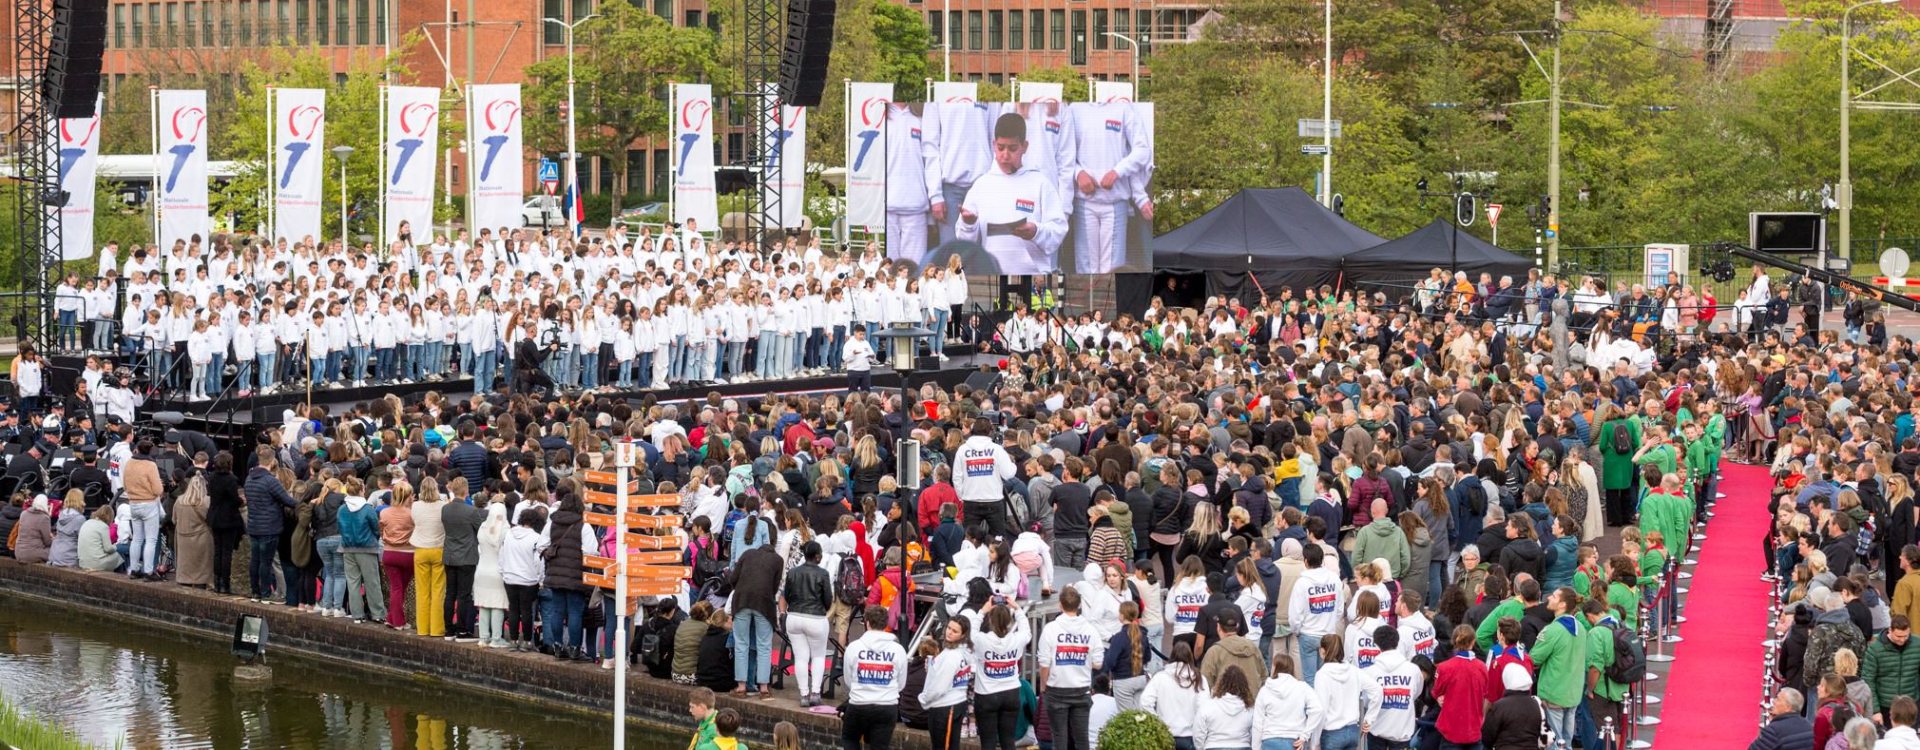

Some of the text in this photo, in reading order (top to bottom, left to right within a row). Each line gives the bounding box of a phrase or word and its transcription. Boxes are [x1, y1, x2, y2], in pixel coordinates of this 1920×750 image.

[965, 448, 995, 457] CREW
[1308, 583, 1336, 595] CREW
[1175, 594, 1206, 604] CREW
[1057, 633, 1091, 644] CREW
[858, 650, 895, 662] CREW
[984, 649, 1018, 660] CREW
[857, 669, 894, 681] KINDER
